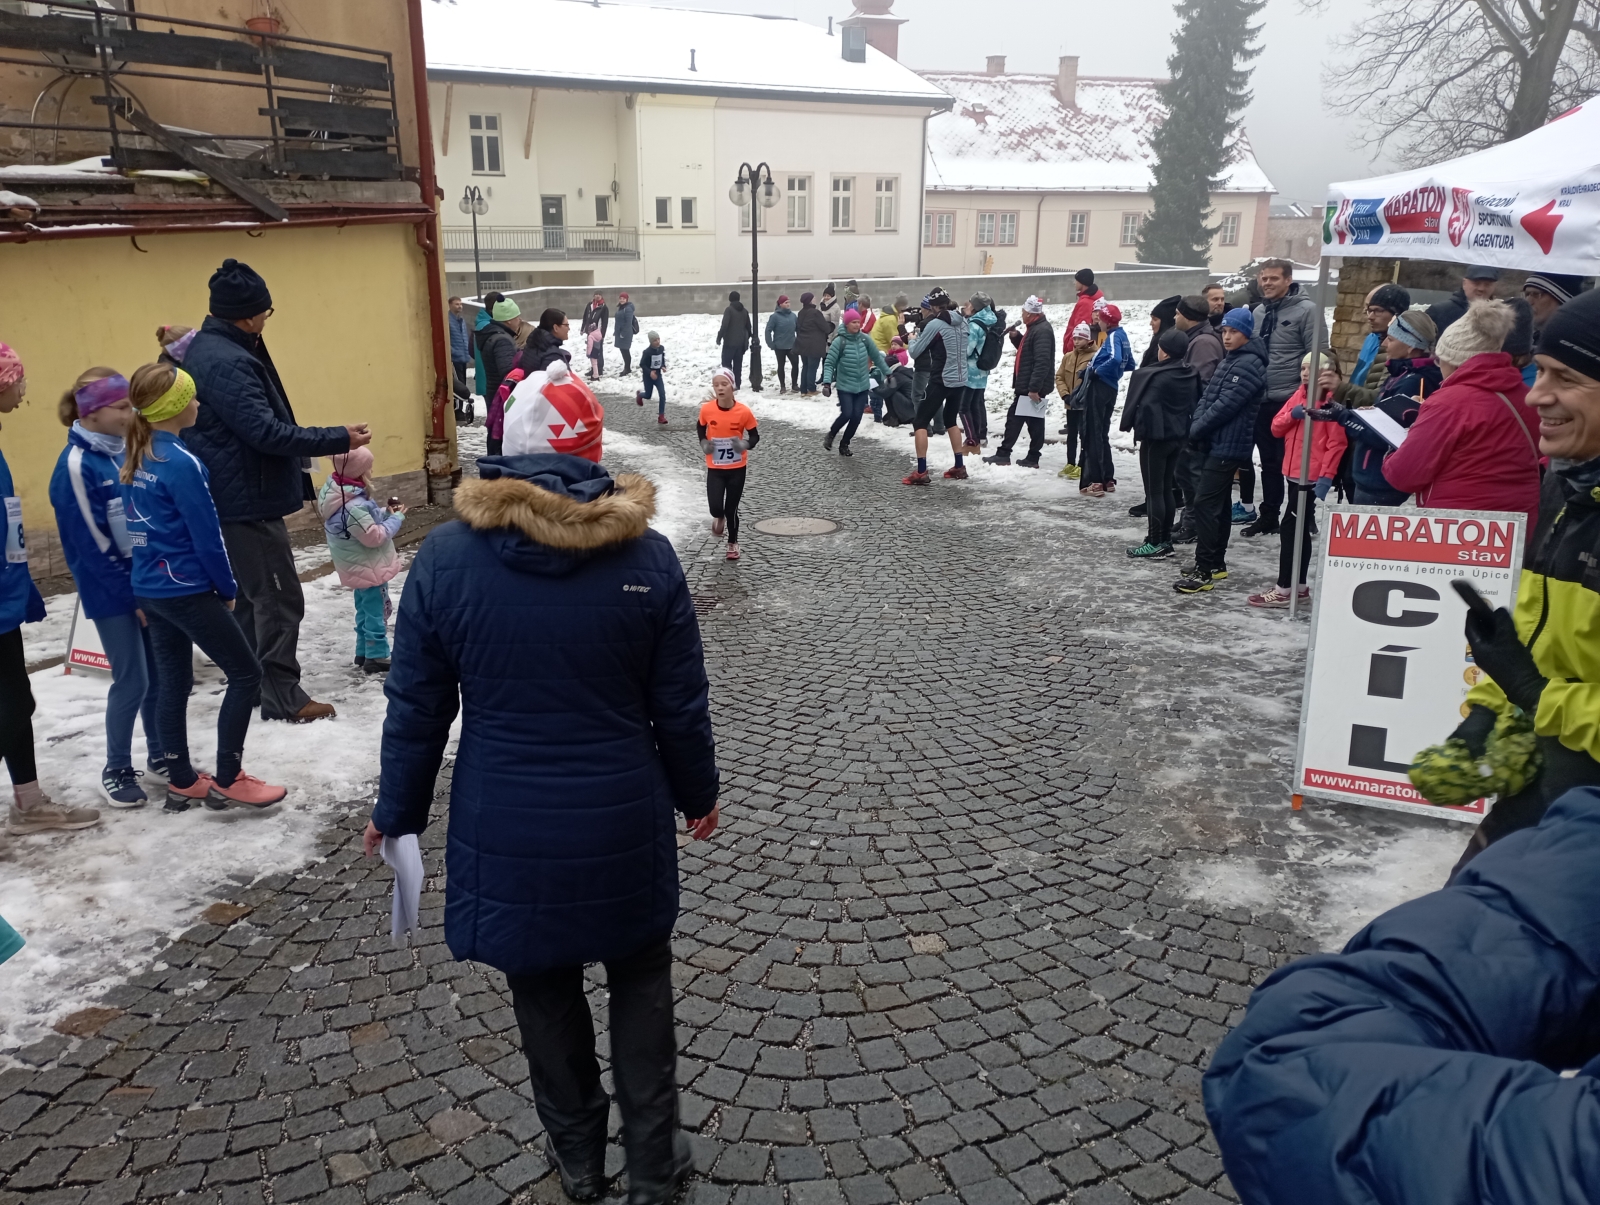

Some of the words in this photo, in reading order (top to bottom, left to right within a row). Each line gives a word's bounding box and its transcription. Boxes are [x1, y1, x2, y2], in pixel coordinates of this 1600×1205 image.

[1561, 182, 1600, 195] KRÁLOVÉHRADEC
[1384, 186, 1446, 216] MARATON
[1558, 199, 1572, 208] KRAJ
[1424, 216, 1439, 228] stav
[1478, 210, 1513, 227] SPORTOVNÍ
[1357, 229, 1370, 240] SVAZ
[1473, 233, 1514, 249] AGENTURA
[717, 448, 734, 460] 75
[1330, 513, 1515, 548] MARATON
[1457, 549, 1506, 563] stav
[1329, 559, 1410, 573] tělovýchovná
[1416, 565, 1465, 577] jednota
[1472, 570, 1509, 580] Úpice
[74, 652, 110, 666] www.ma
